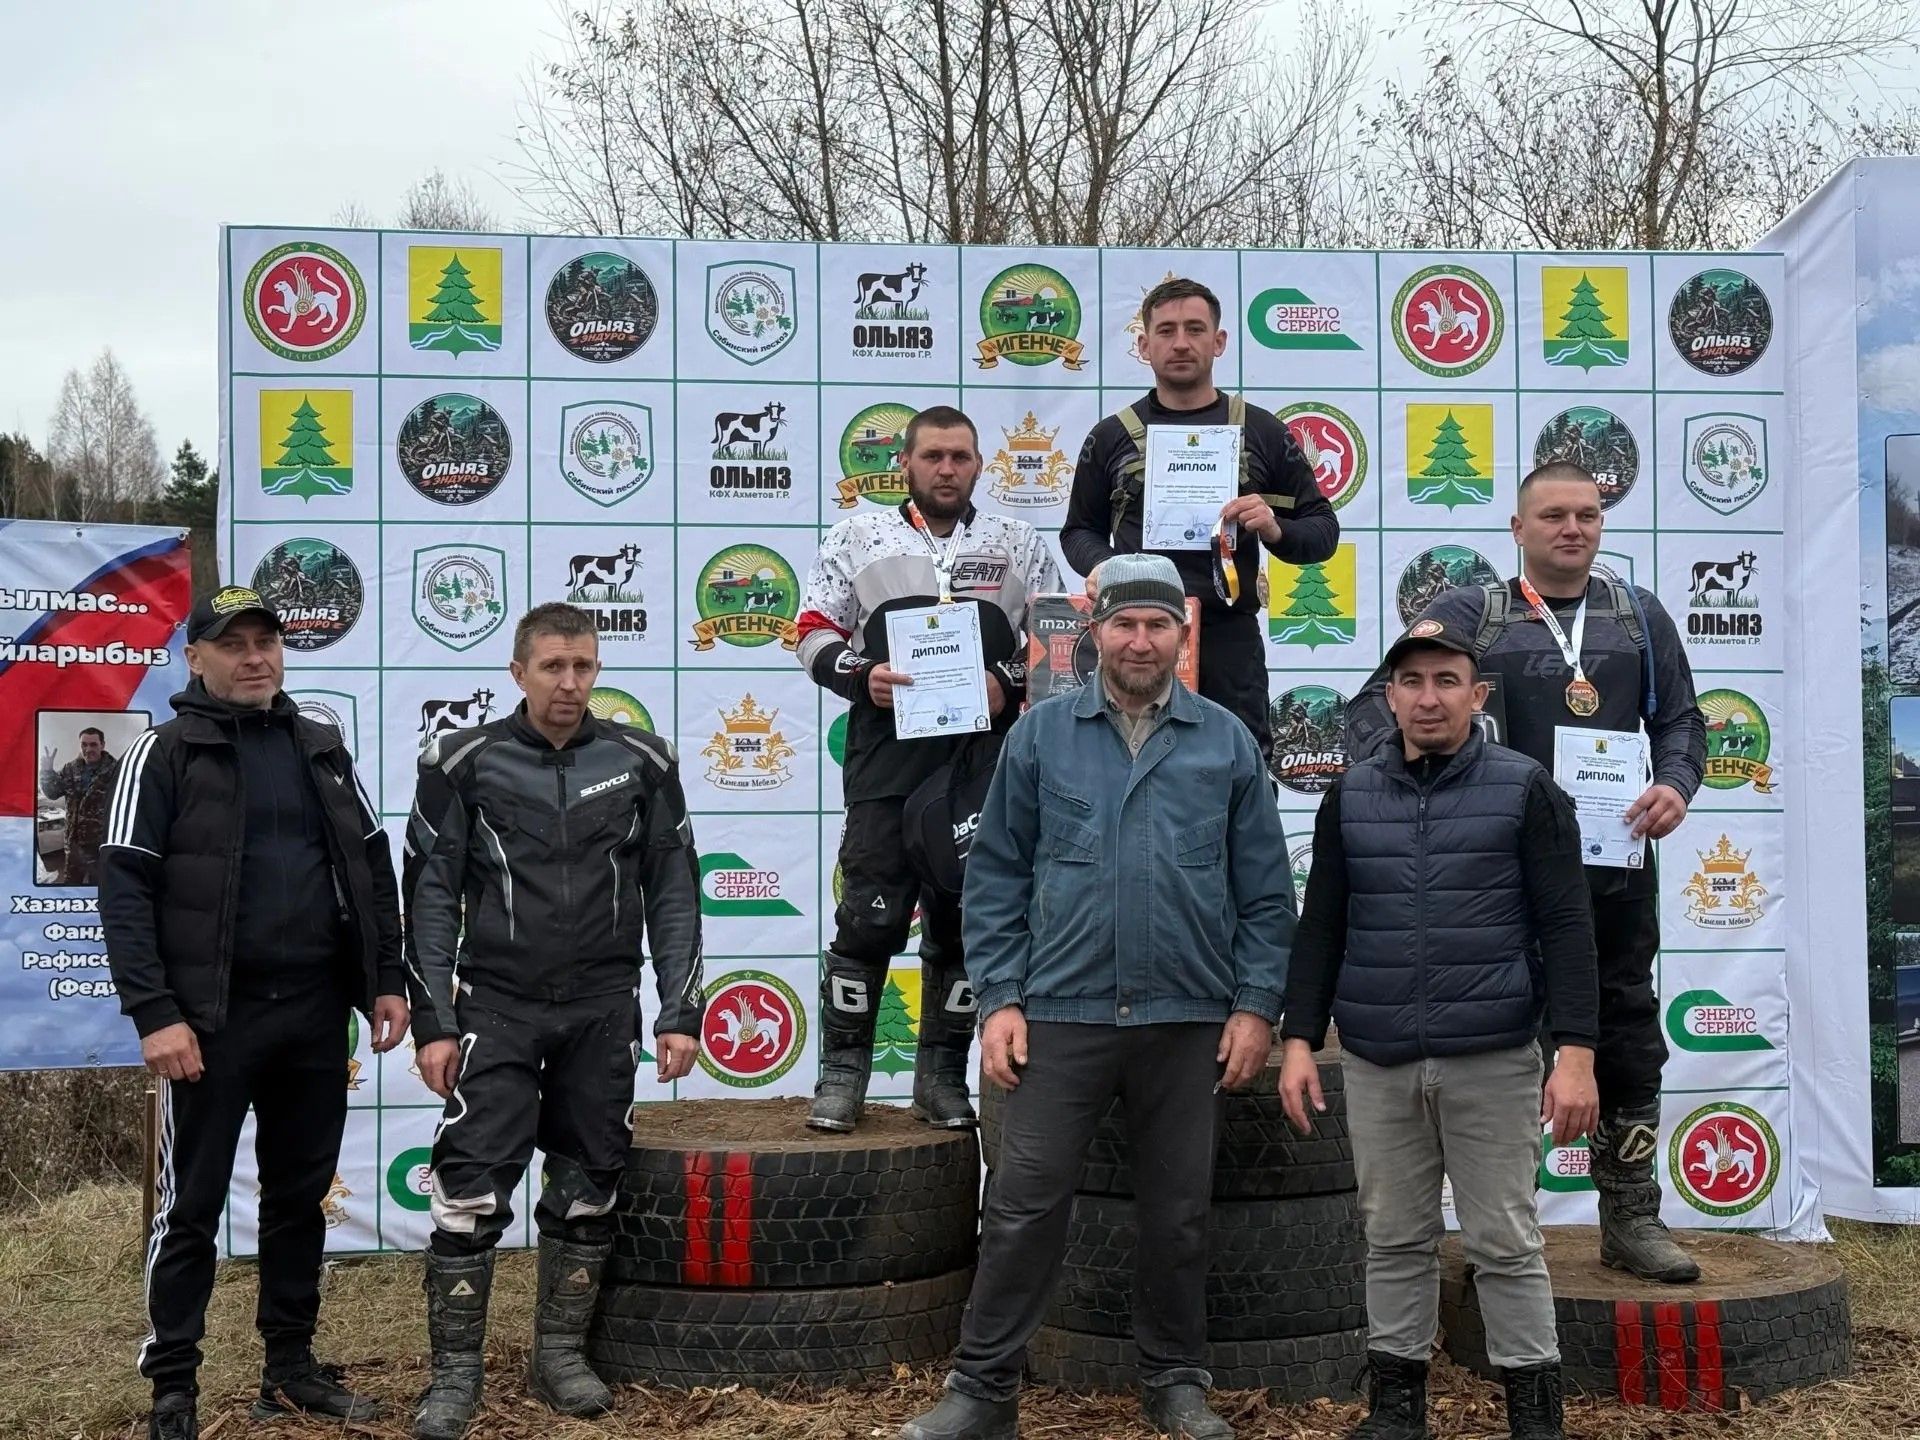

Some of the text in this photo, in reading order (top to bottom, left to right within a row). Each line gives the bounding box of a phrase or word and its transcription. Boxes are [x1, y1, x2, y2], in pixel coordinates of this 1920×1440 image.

[1276, 307, 1339, 319] ЭНЕРГО
[570, 320, 635, 337] ОЛЫЯЗ
[1277, 320, 1341, 332] СЕРВИС
[580, 332, 626, 343] ЭНДУРО
[712, 329, 789, 353] Сабинский лесхоз
[852, 325, 933, 349] ОЛЫЯЗ
[996, 334, 1066, 354] ИГЕНЧЕ
[1691, 334, 1752, 352] ОЛЫЯЗ
[852, 350, 932, 359] КФХ Ахметов Г.Р.
[1700, 346, 1742, 357] ЭНДУРО
[422, 462, 489, 480] ОЛЫЯЗ
[1168, 462, 1216, 472] ДИПЛОМ
[432, 474, 480, 486] ЭНДУРО
[567, 471, 645, 495] Сабинский лесхоз
[710, 465, 792, 490] ОЛЫЯЗ
[855, 474, 909, 493] ИГЕН
[709, 490, 790, 499] КФХ Ахметов Г.Р.
[1690, 480, 1760, 504] Сабинский лесхоз
[1034, 496, 1058, 504] Мебель
[0, 588, 149, 614] ылмас...
[284, 620, 330, 632] ЭНДУРО
[420, 615, 498, 639] Сабинский лесхоз
[583, 609, 648, 632] ЛЫЯЗ
[712, 615, 784, 635] ИГЕНЧЕ
[1687, 612, 1762, 636] ОЛЫЯЗ
[599, 634, 630, 642] метов
[1748, 637, 1761, 645] Г.Р.
[0, 636, 172, 668] йларыбыз
[911, 644, 960, 659] ДИПЛОМ
[1280, 752, 1344, 770] ОЛЫЯЗ
[1704, 758, 1756, 778] ГЕНЧЕ
[1290, 764, 1335, 775] ЭНДУРО
[1576, 770, 1625, 783] ДИПЛОМ
[751, 778, 778, 787] Мебель
[714, 872, 780, 884] ЭНЕРГО
[714, 886, 780, 898] СЕРВИС
[10, 896, 100, 914] Хазиах
[1728, 917, 1751, 926] Мебель
[44, 922, 106, 942] Фанд
[22, 950, 110, 973] Рафисо
[1694, 1008, 1756, 1020] ЭНЕРГО
[1694, 1021, 1757, 1034] СЕРВИС
[1557, 1150, 1590, 1162] ЭНЕ
[1557, 1163, 1591, 1175] СЕР
